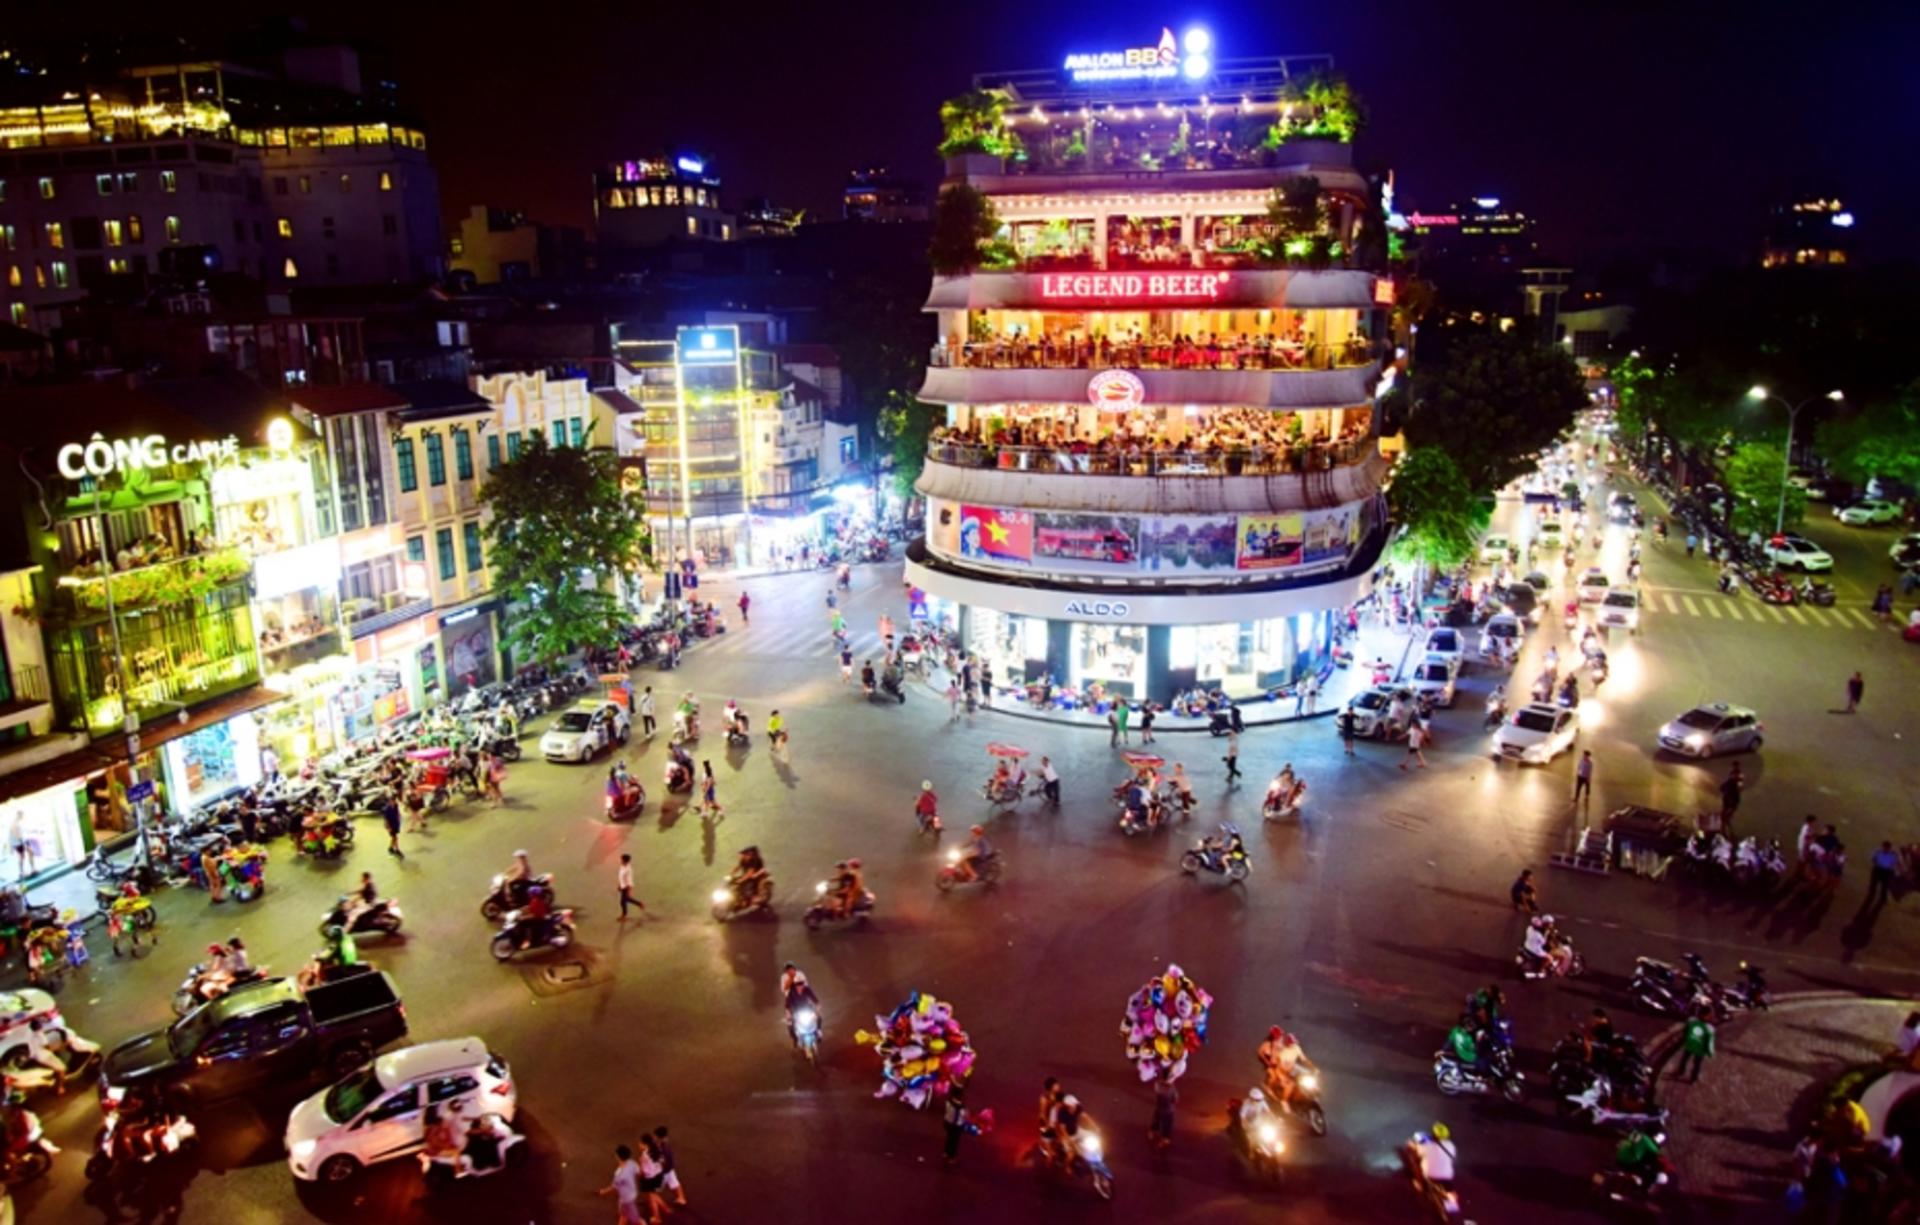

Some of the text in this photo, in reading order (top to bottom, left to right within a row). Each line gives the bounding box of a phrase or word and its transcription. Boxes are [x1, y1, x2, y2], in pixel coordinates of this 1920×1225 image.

[1065, 47, 1180, 69] AVALON BBQ
[1043, 274, 1218, 301] LEGEND BEER
[1065, 601, 1128, 617] ALDO
